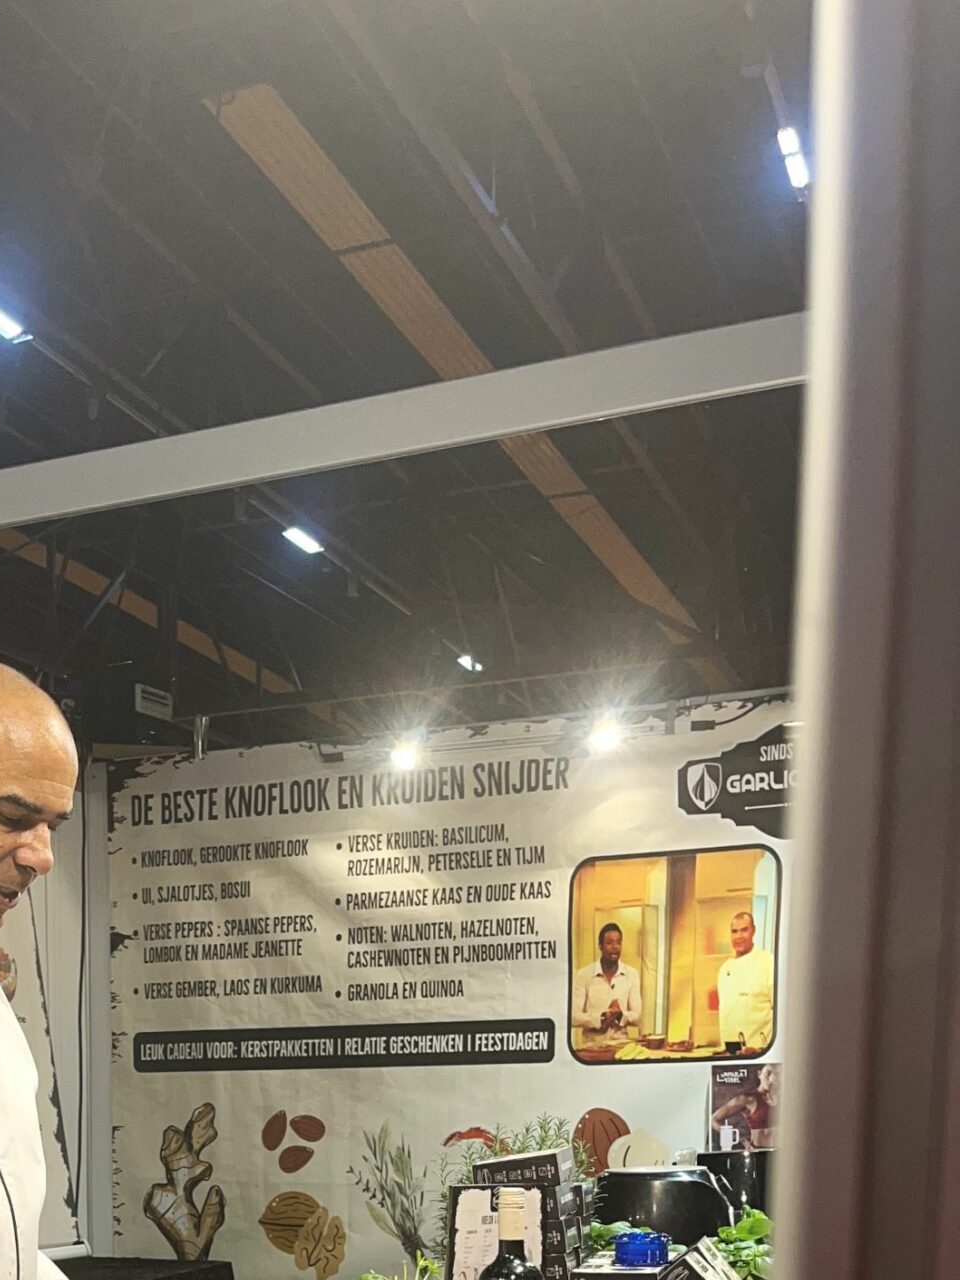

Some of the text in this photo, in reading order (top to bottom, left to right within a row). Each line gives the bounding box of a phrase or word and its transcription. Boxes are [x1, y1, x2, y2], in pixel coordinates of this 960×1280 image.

[759, 742, 794, 763] SINDS
[131, 756, 571, 827] DE BESTE KNOFLOOK EN KRUIDEN SNIJDER
[348, 823, 509, 853] VERSE KRUIDEN: BASILICUM,
[141, 838, 310, 869] KNOFLOOK, GEROOKTE KNOFLOOK
[347, 845, 546, 877] ROZEMARIJN, PETERSELIE EN TIJM
[141, 881, 251, 906] UI, SJALOTJES, BOSUI
[346, 880, 553, 911] PARMEZAANSE KAAS EN OUDE KAAS
[143, 923, 173, 942] VERSE
[174, 920, 214, 940] PEPERS
[223, 916, 271, 937] SPAANSE
[273, 914, 318, 935] PEPERS,
[347, 916, 539, 946] NOTEN: WALNOTEN, HAZELNOTEN,
[143, 938, 303, 964] LOMBOK EN MADAME JEANETTE
[347, 940, 557, 969] CASHEWNOTEN EN PIJNBOOMPITTEN
[144, 975, 323, 1000] VERSE GEMBER, LAOS EN KURKUMA
[348, 979, 465, 1002] GRANOLA EN QUINOA
[141, 1042, 166, 1062] LEUK
[167, 1040, 205, 1060] CADEAU
[206, 1039, 239, 1060] VOOR:
[240, 1037, 335, 1059] KERSTPAKKETTEN
[344, 1035, 388, 1057] RELATIE
[389, 1033, 464, 1055] GESCHENKEN
[474, 1030, 549, 1052] FEESTDAGEN
